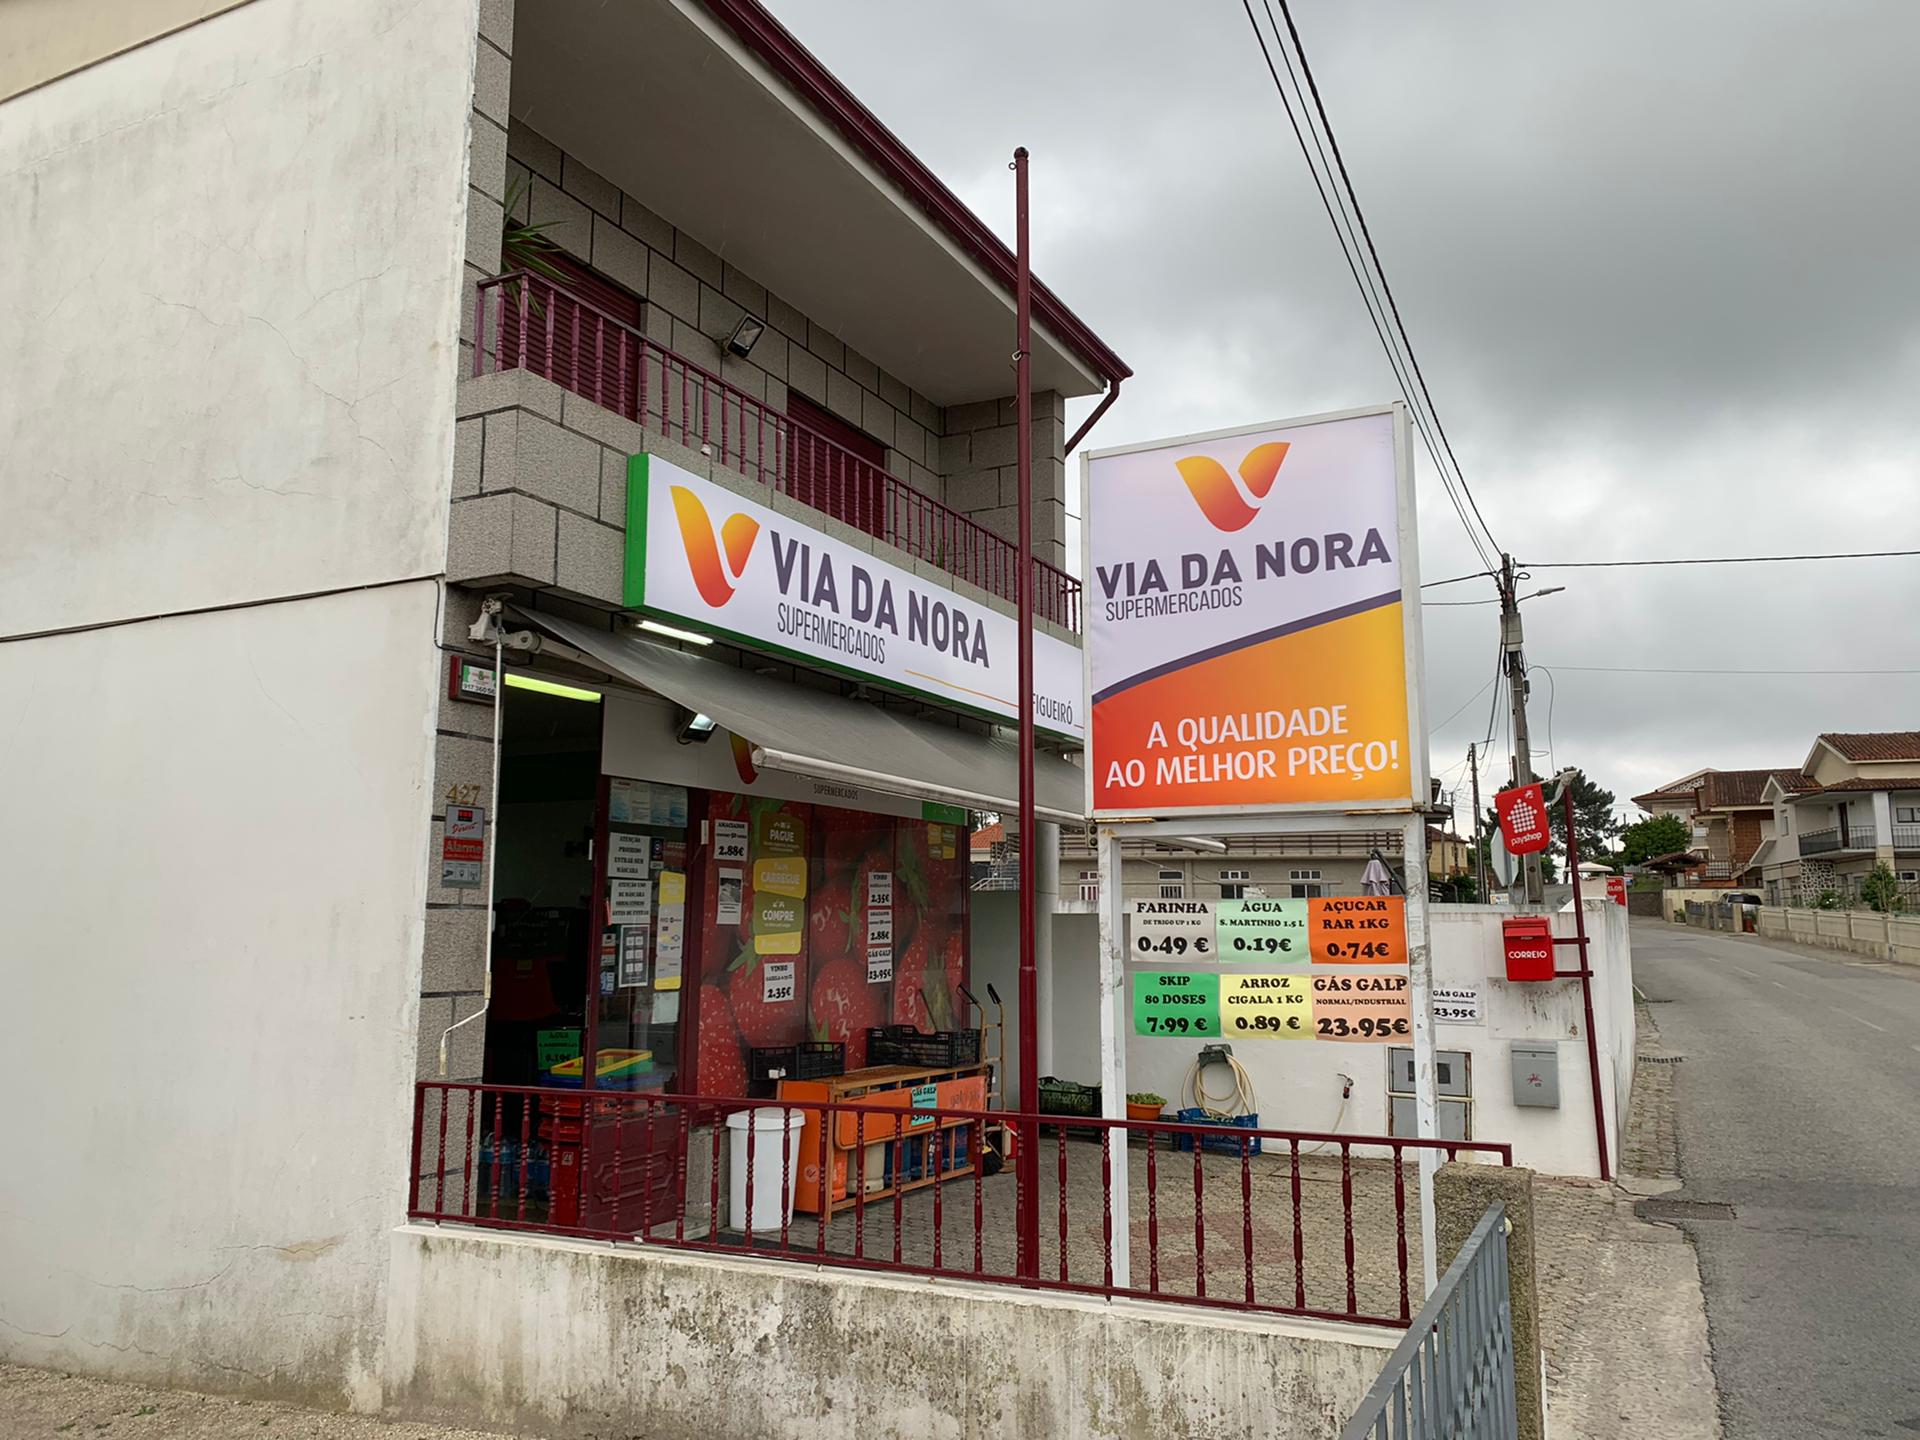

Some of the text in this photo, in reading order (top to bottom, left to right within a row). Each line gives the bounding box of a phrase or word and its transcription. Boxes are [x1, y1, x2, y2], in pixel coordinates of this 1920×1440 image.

[1096, 527, 1392, 600] VIA DA NORA
[770, 530, 990, 669] VIA DA NORA
[1105, 586, 1243, 622] SUPERMERCADOS
[777, 602, 885, 665] SUPERMERCADOS
[1146, 704, 1348, 752] A QUALIDADE
[1105, 739, 1399, 789] AO MELHOR PREÇO!
[813, 783, 859, 801] SUPERMERCADOS
[769, 829, 794, 842] PAGUE
[1511, 832, 1543, 847] payshop
[718, 845, 744, 857] 2.88€
[1137, 902, 1209, 914] FARINHA
[1241, 901, 1283, 913] ÁGUA
[1323, 901, 1387, 914] AÇUCAR
[762, 909, 795, 921] COMPRE
[1230, 919, 1281, 927] MARTINHO
[1323, 919, 1389, 929] RAR 1KG
[1138, 936, 1209, 955] 0.49 €
[1233, 937, 1292, 954] 0.19€
[1327, 942, 1389, 959] 0.74€
[1508, 950, 1547, 959] CORREIO
[1159, 976, 1190, 986] SKIP
[1240, 978, 1290, 989] ARROZ
[1313, 976, 1408, 991] GÁS GALP
[768, 986, 791, 999] 2.35€
[1145, 994, 1206, 1004] 80 DOSES
[1227, 995, 1274, 1004] CIGALA
[1285, 994, 1304, 1004] KG
[1432, 989, 1477, 999] GÁS GALP
[1316, 998, 1407, 1006] NORMAL/INDUSTRIAL
[1433, 1007, 1477, 1019] 23.95€
[1146, 1017, 1208, 1033] 7.99 €
[1235, 1015, 1301, 1032] 0.89 €
[1317, 1018, 1410, 1038] 23.95€
